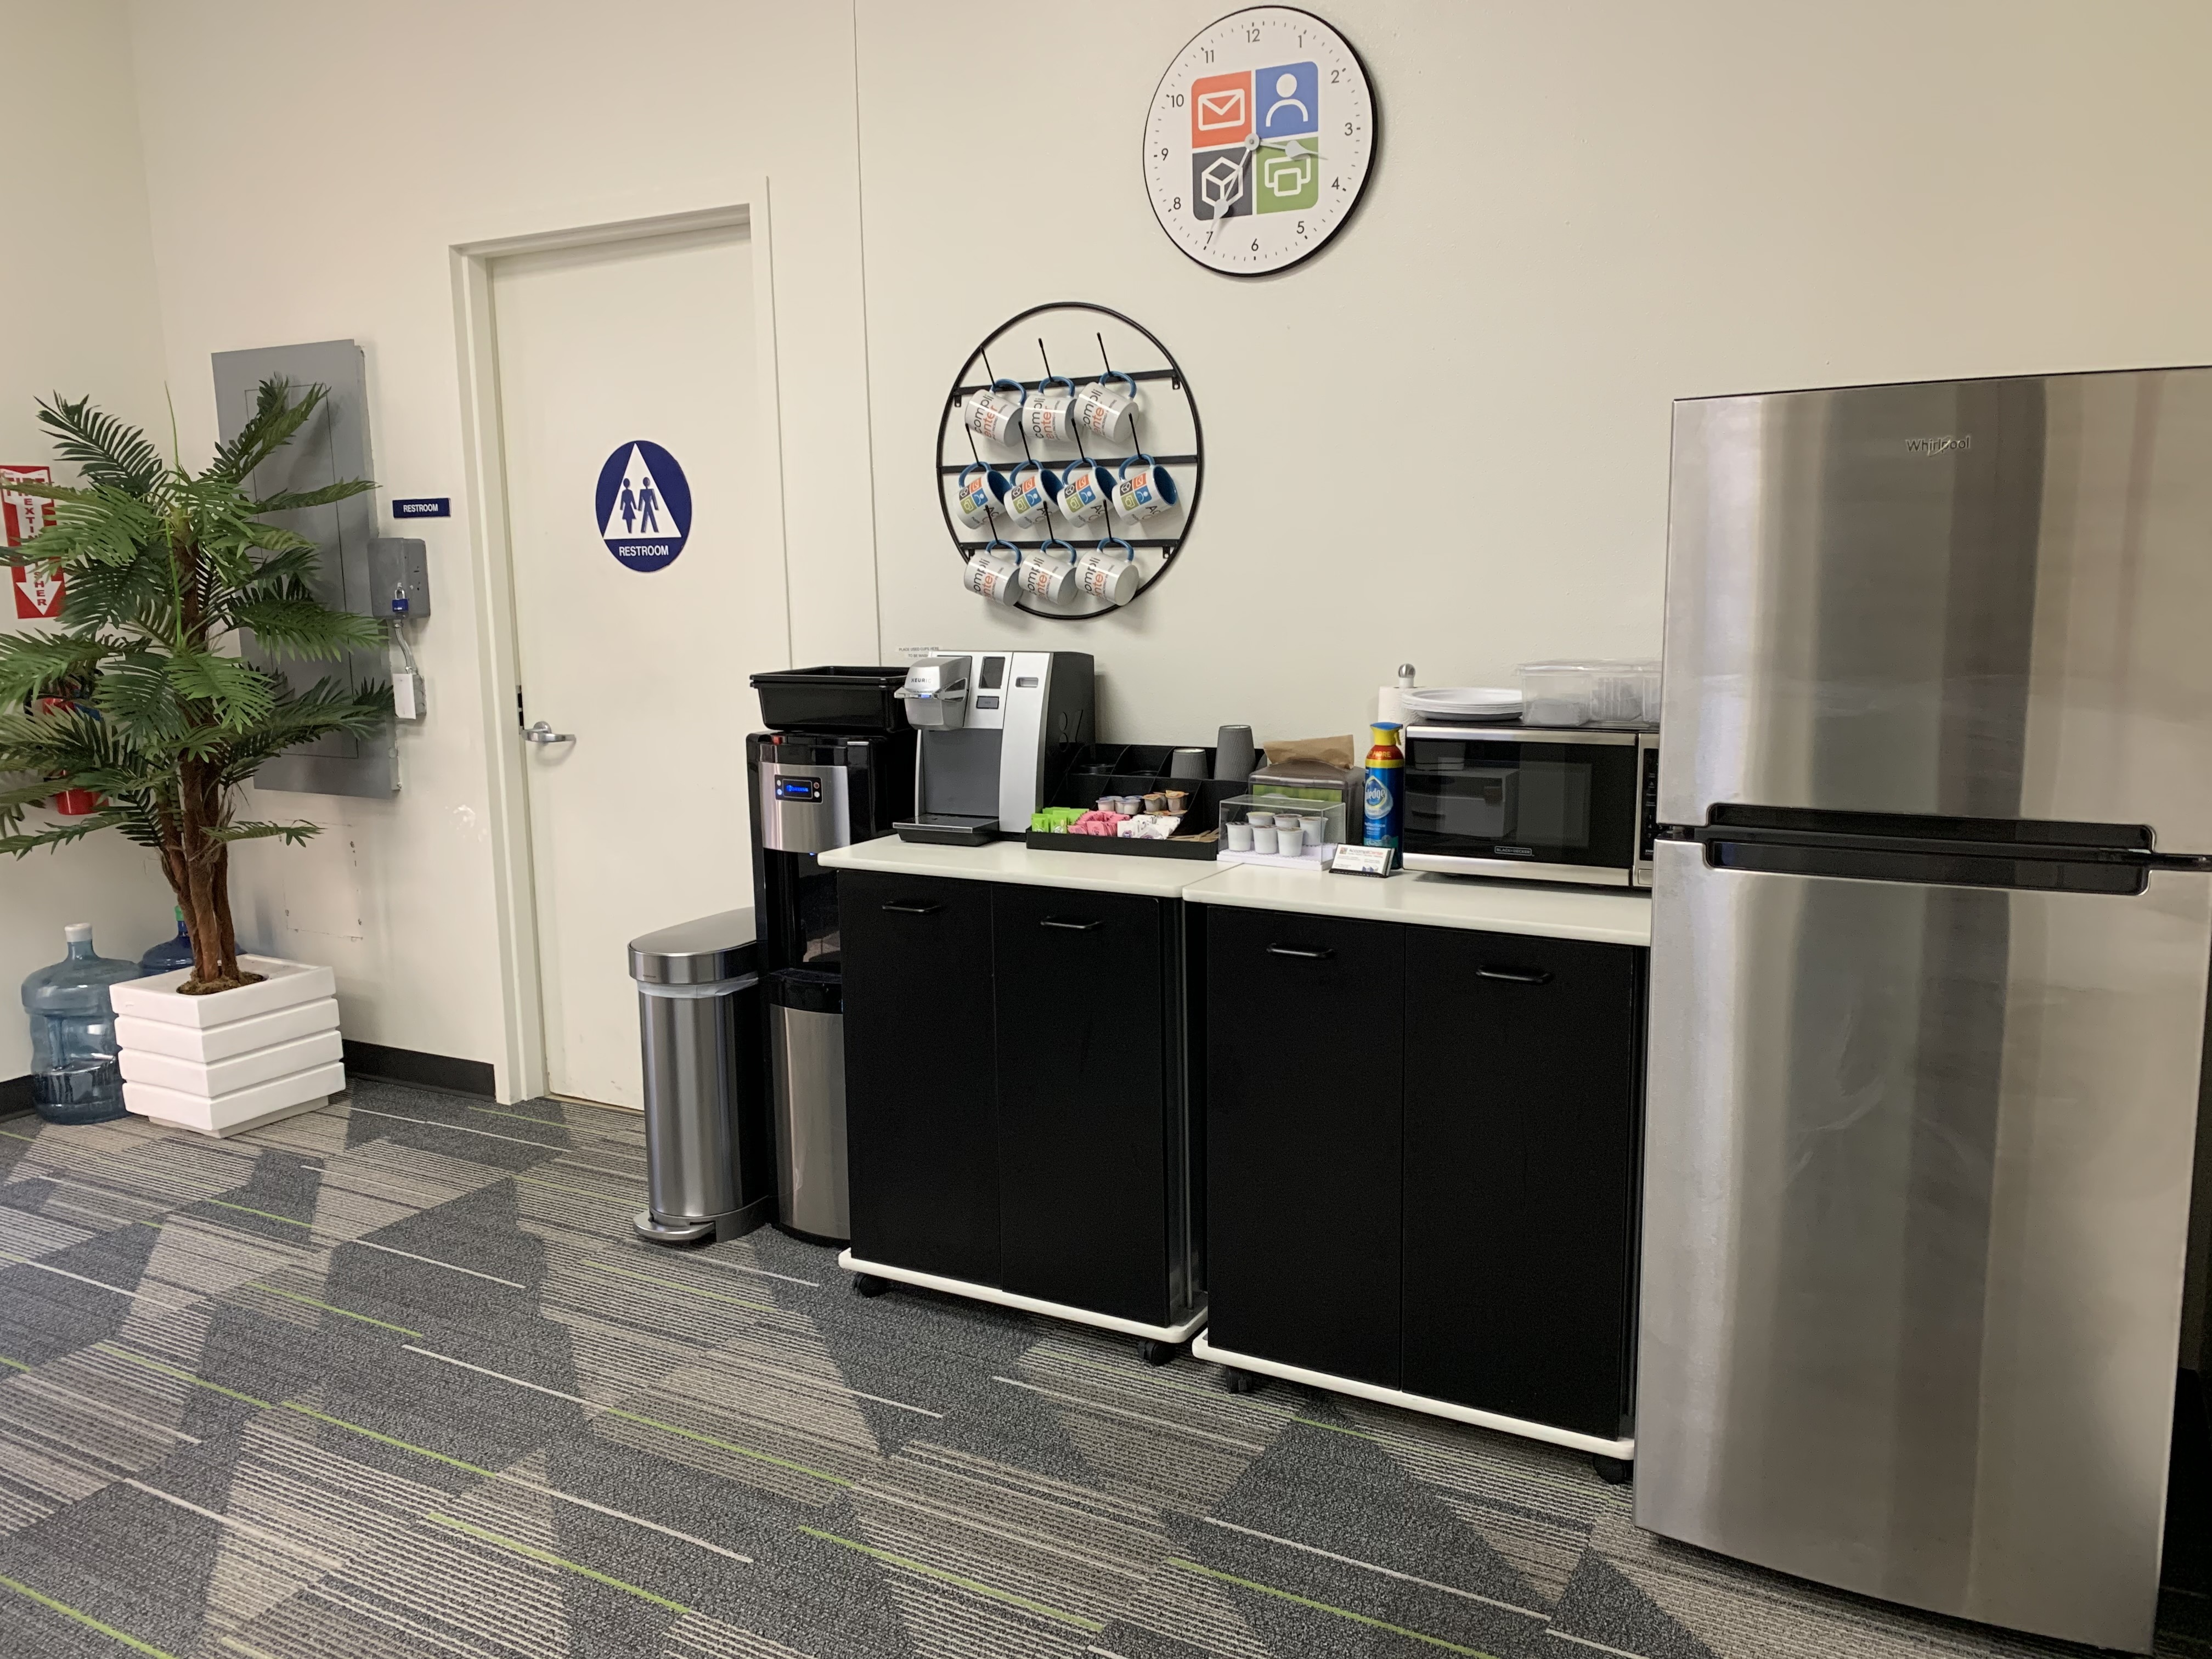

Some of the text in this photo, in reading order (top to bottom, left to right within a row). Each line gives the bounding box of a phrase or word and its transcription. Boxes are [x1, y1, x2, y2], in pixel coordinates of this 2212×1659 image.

[1246, 29, 1260, 43] 12
[1298, 35, 1302, 48] 1
[1205, 50, 1214, 63] 11
[1331, 70, 1339, 83] 2
[1171, 94, 1184, 108] 10
[1345, 122, 1353, 136] 3
[1161, 148, 1169, 161] 9
[1331, 177, 1340, 189] 4
[1173, 197, 1181, 210] 8
[1296, 221, 1305, 234] 5
[1206, 231, 1214, 244] 7
[1251, 238, 1259, 251] 6
[1906, 436, 1970, 453] Whirlpool
[403, 504, 438, 512] RESTROOM
[619, 545, 669, 556] RESTROOM
